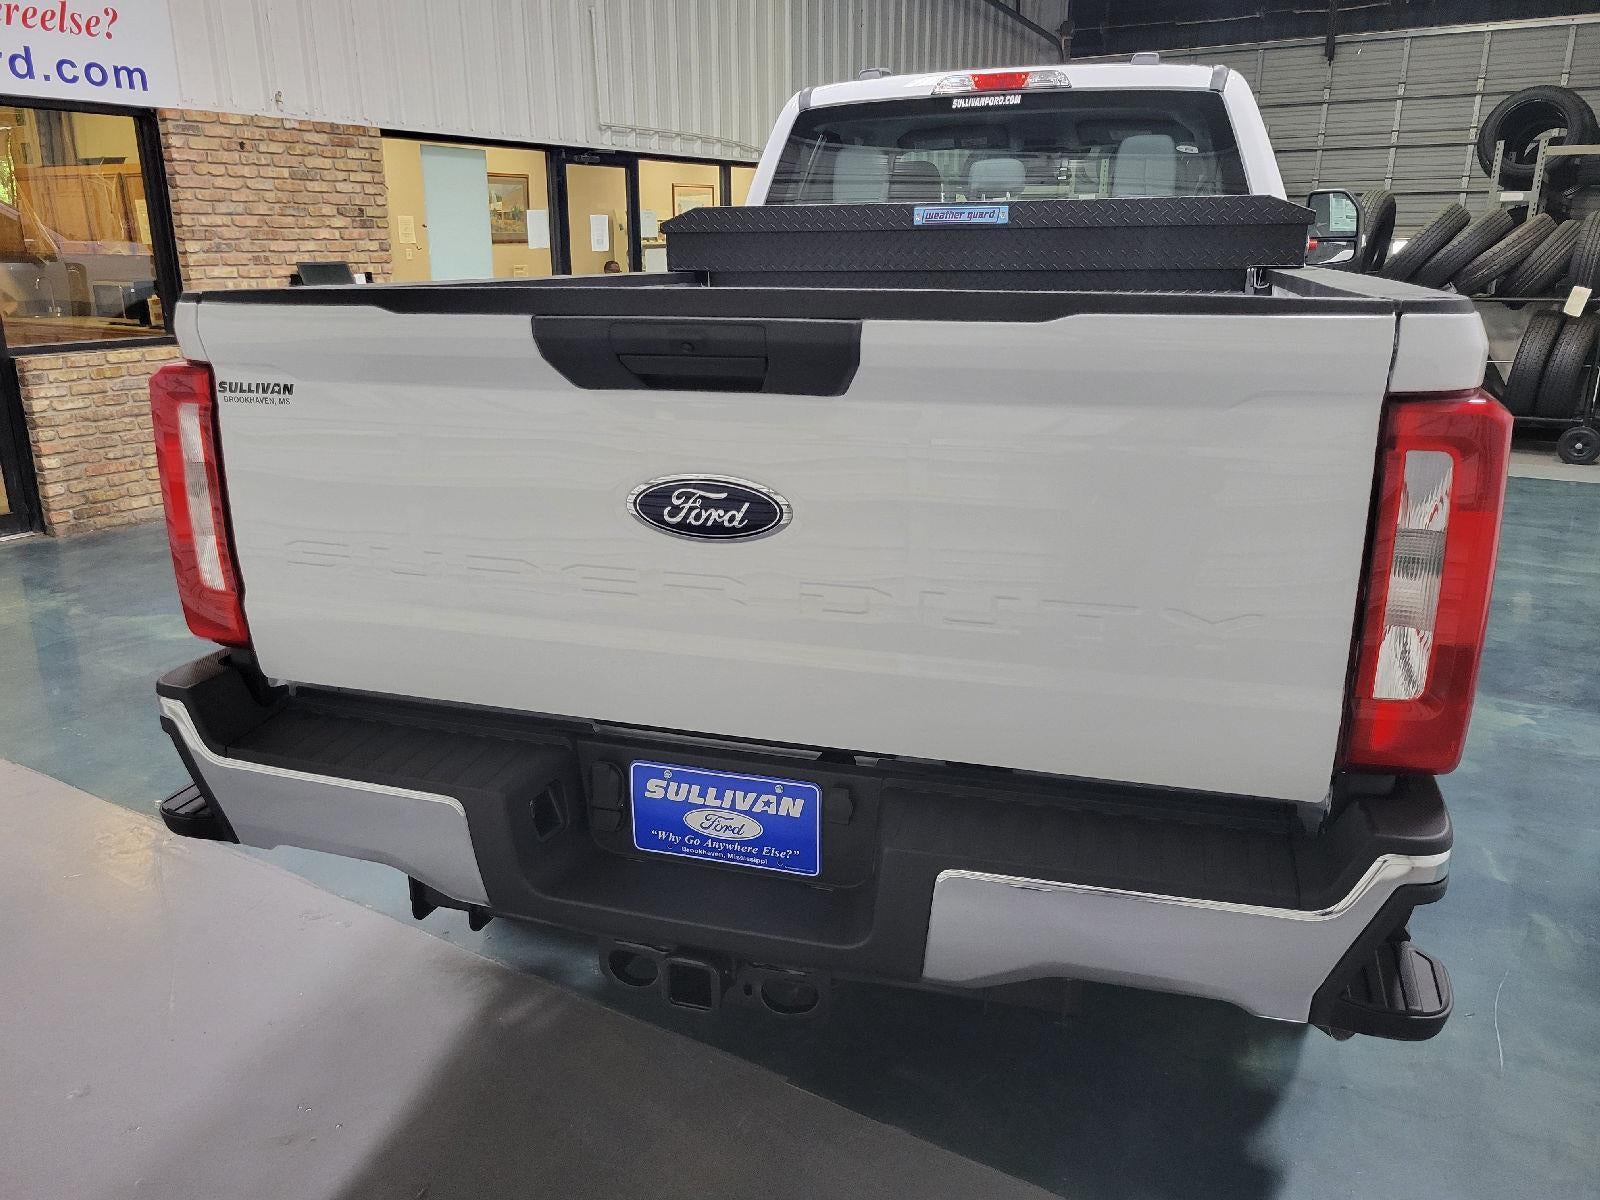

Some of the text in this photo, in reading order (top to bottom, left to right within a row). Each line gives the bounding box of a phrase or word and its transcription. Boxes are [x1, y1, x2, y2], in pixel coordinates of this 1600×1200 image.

[0, 0, 119, 40] reelse?
[0, 46, 149, 92] d.com
[952, 95, 1021, 108] SULLIVANFORD.COM
[925, 209, 996, 220] weather guard
[218, 381, 294, 395] SULLIVAN
[224, 396, 291, 405] BROOKHAVEN, MS
[663, 488, 750, 529] Ford
[645, 779, 804, 817] SULLIVAN
[700, 813, 746, 836] Ford
[684, 834, 701, 846] Go
[703, 838, 759, 856] Anywhere
